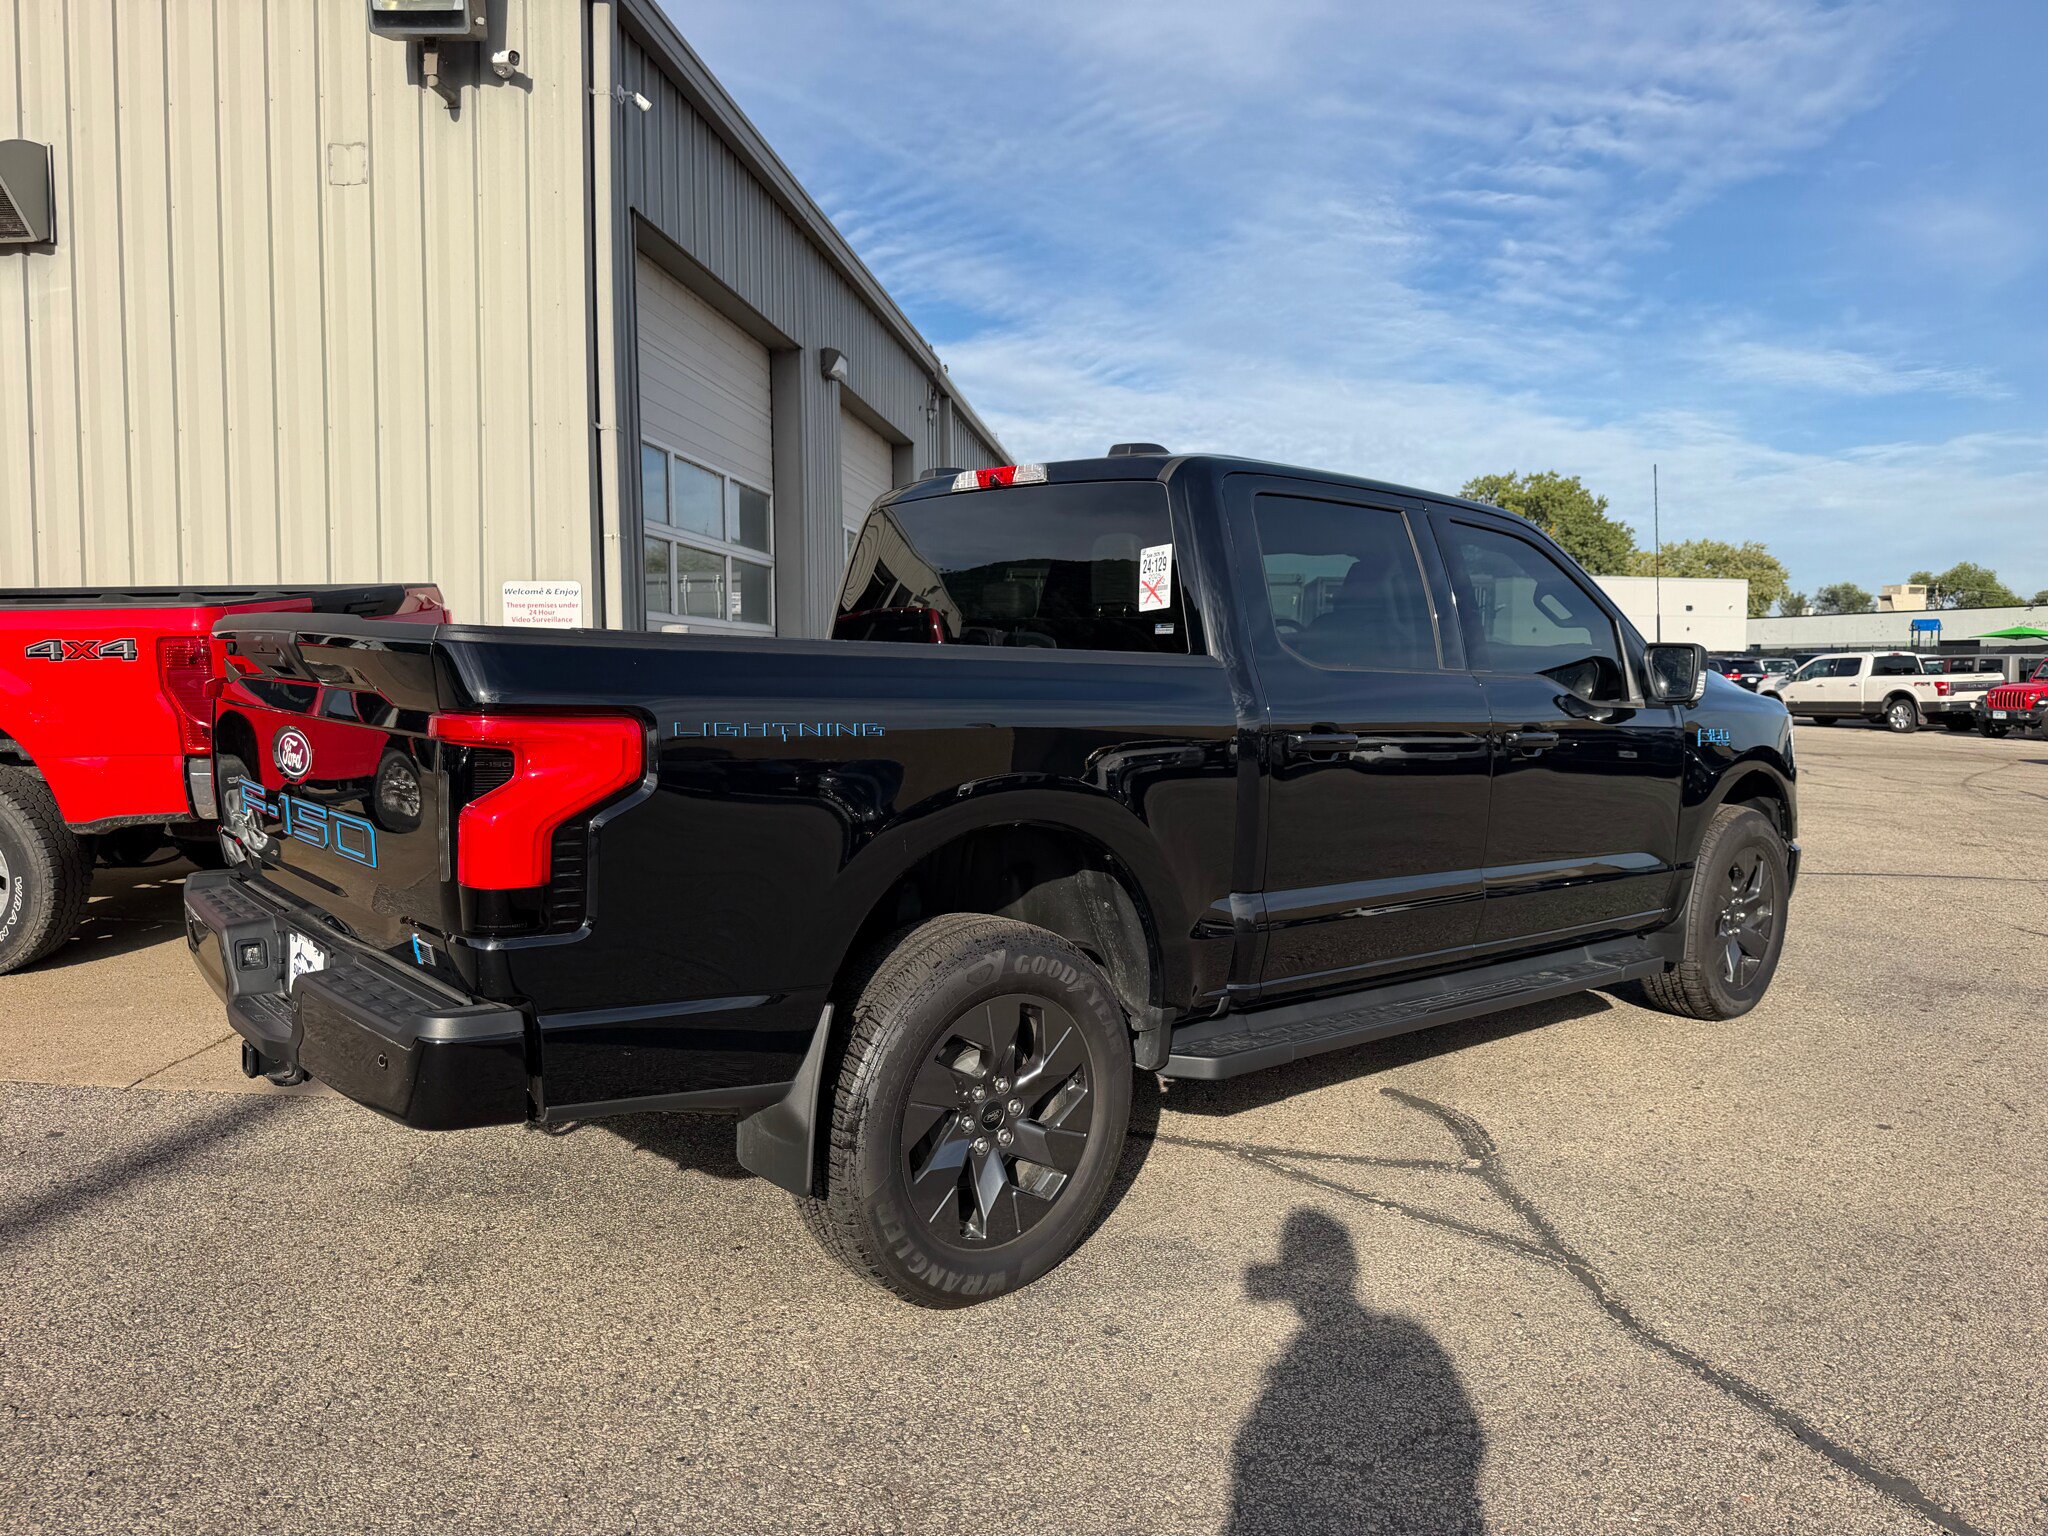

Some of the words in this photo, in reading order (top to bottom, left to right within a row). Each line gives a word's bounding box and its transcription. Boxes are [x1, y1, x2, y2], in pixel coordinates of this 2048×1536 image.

[504, 587, 545, 596] Welcome
[554, 588, 579, 597] Enjoy
[527, 602, 558, 610] premises
[674, 721, 885, 742] LIGHTNING
[282, 737, 304, 770] Ford
[238, 775, 378, 869] F-150
